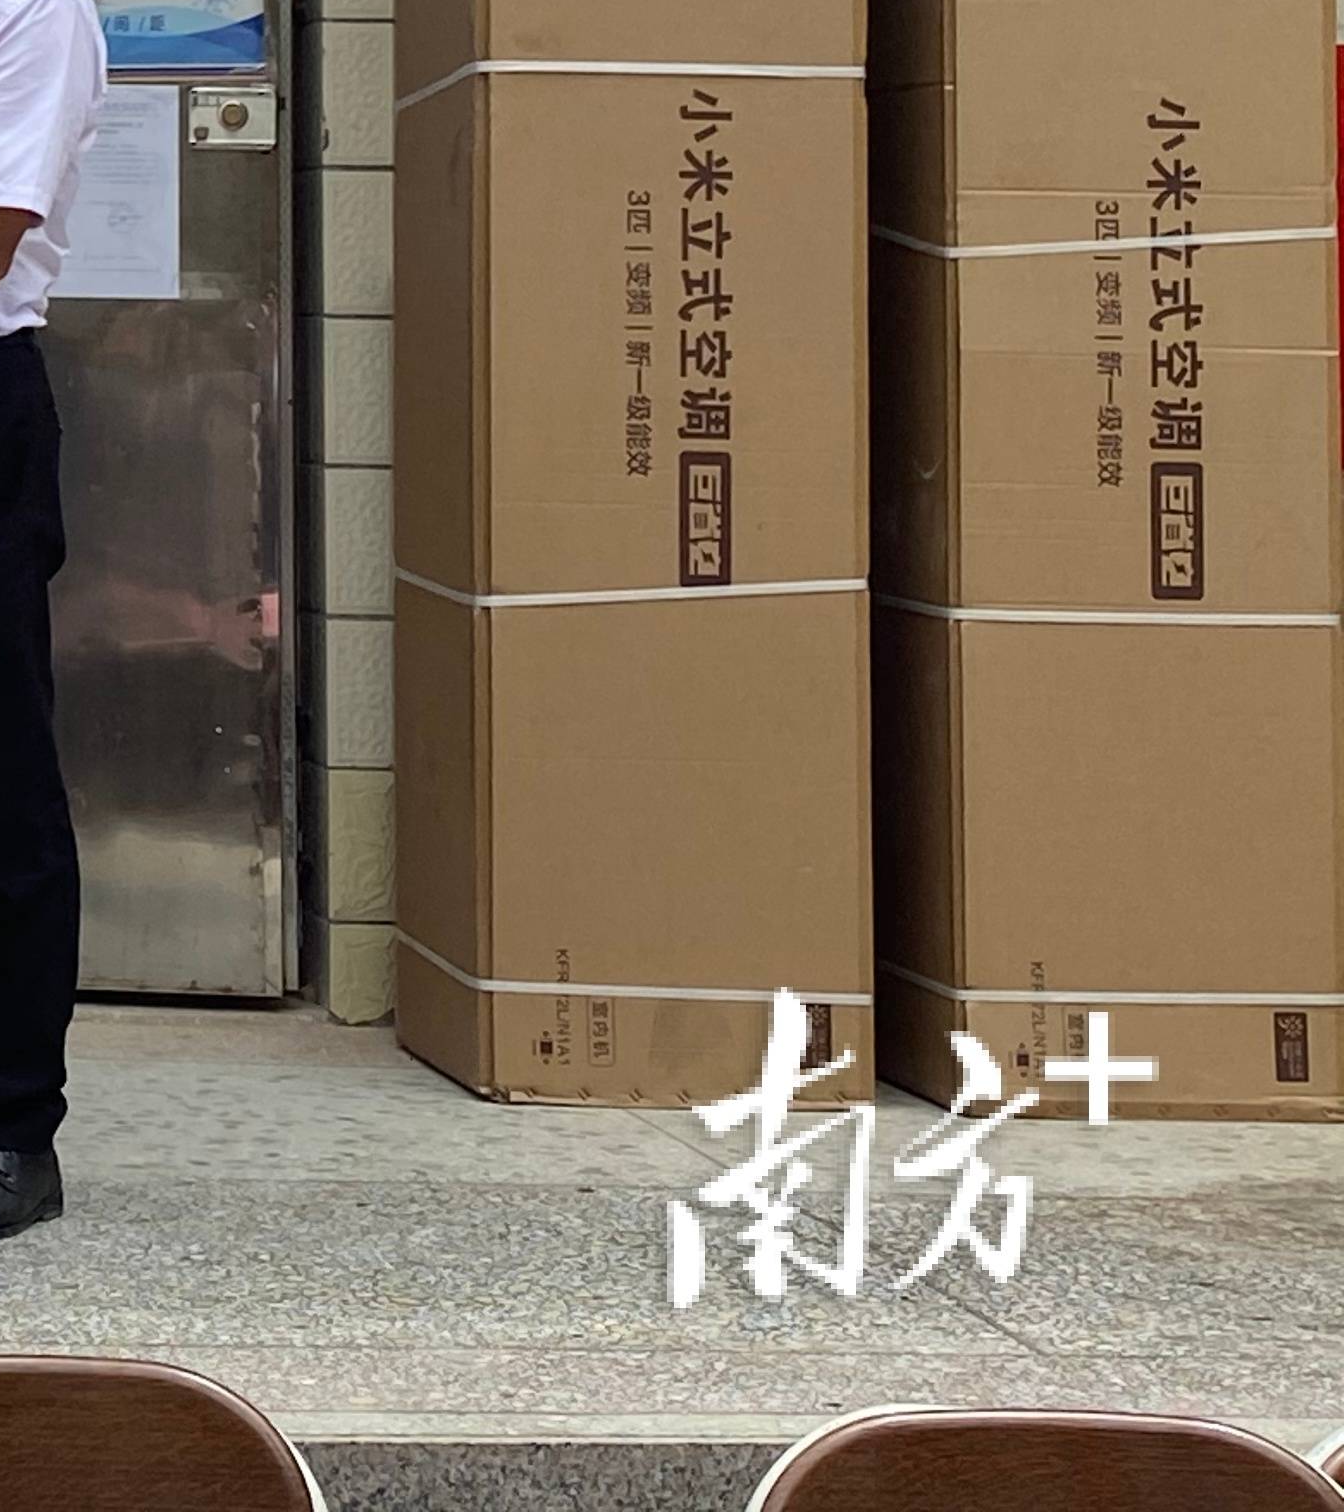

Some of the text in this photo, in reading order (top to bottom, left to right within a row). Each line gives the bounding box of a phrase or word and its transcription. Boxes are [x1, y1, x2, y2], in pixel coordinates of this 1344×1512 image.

[678, 88, 734, 441] 小米立式空调
[1146, 96, 1204, 451] 小米立式空调
